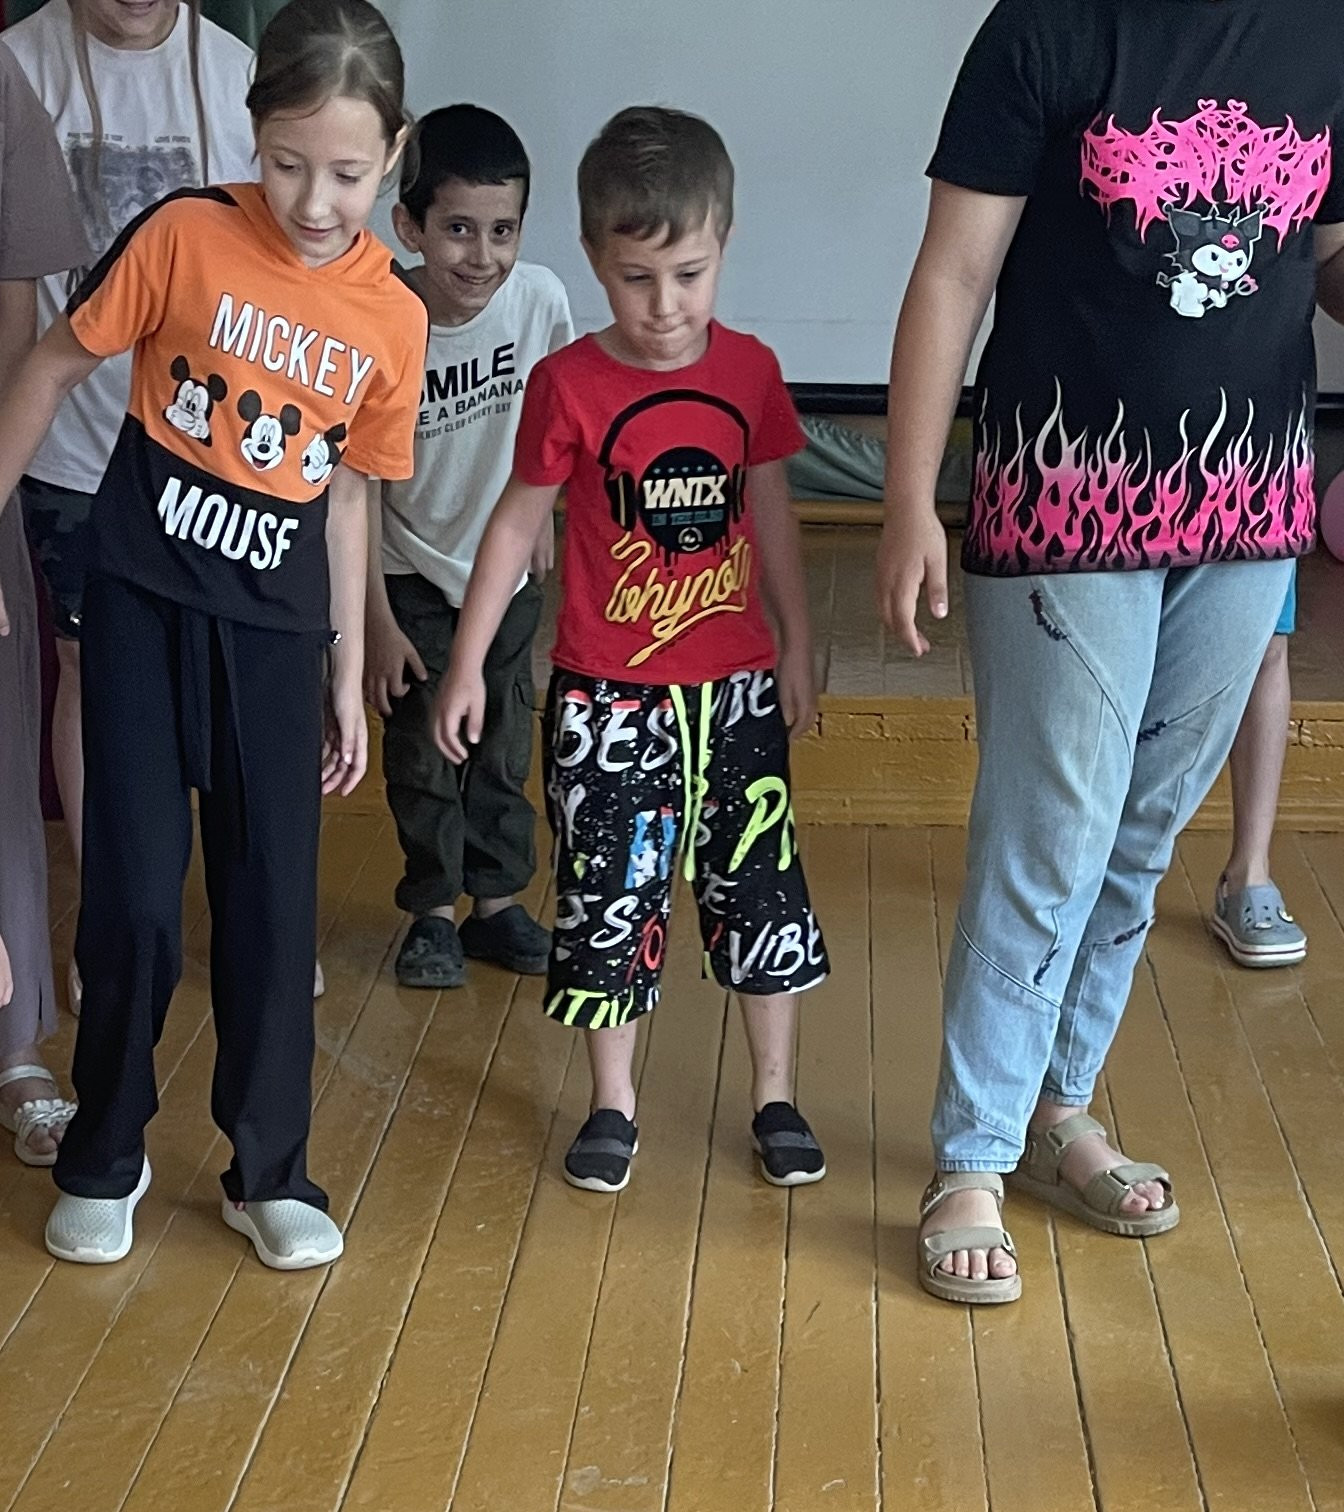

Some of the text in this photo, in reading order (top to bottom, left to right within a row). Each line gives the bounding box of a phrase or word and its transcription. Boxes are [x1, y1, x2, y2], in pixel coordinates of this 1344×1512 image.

[208, 292, 374, 405] MICKEY
[419, 342, 516, 405] MILE
[437, 406, 449, 422] A
[455, 378, 525, 416] BANANA
[157, 476, 300, 571] MOUSE
